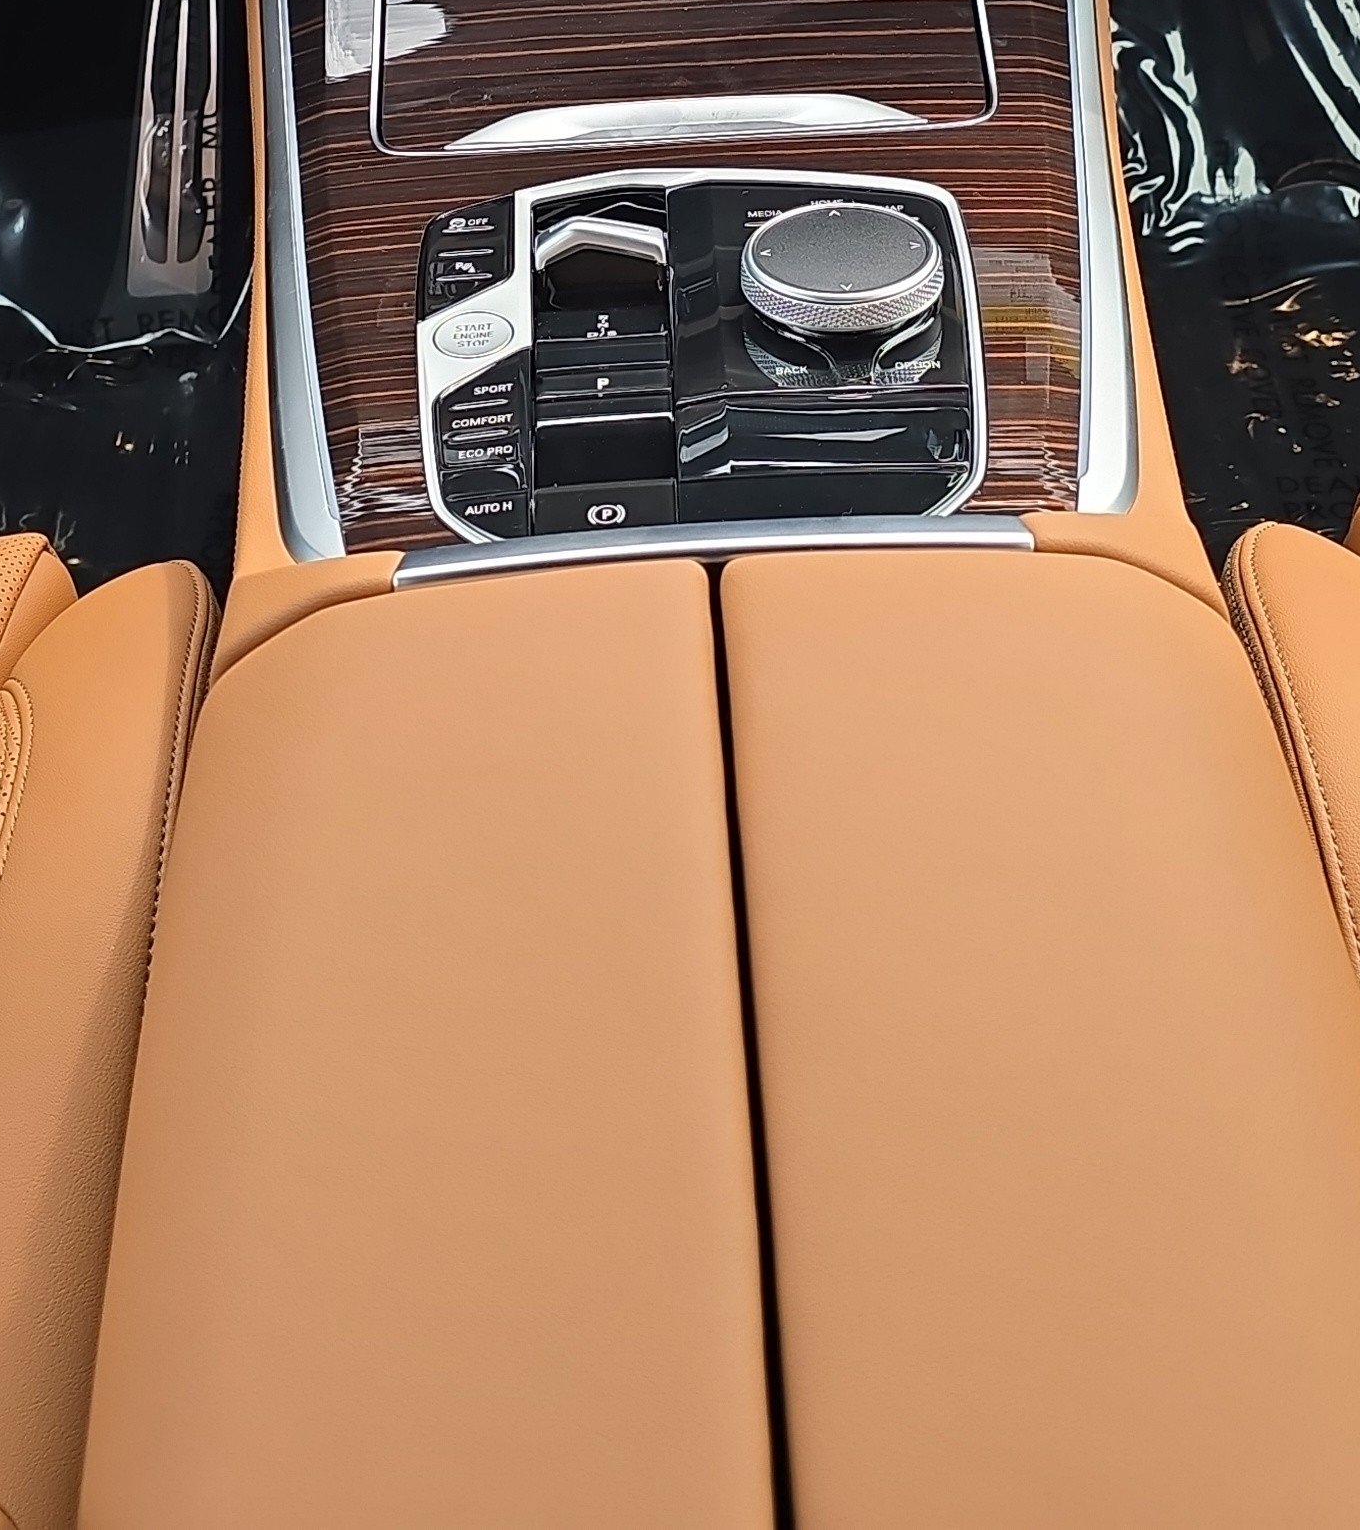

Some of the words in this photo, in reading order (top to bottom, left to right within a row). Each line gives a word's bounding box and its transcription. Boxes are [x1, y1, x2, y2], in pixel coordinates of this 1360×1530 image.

[747, 209, 782, 218] MEDIA
[468, 218, 489, 226] OFF
[455, 323, 493, 332] START
[453, 330, 494, 340] ENGINE
[457, 339, 489, 348] STOP
[776, 365, 808, 375] BACK
[894, 360, 941, 370] OPTION
[597, 378, 610, 390] P
[474, 383, 513, 396] SPORT
[452, 413, 513, 429] COMFORT
[458, 448, 484, 459] ECO
[487, 445, 513, 456] PRO
[464, 502, 500, 516] AUTO
[502, 500, 513, 511] H
